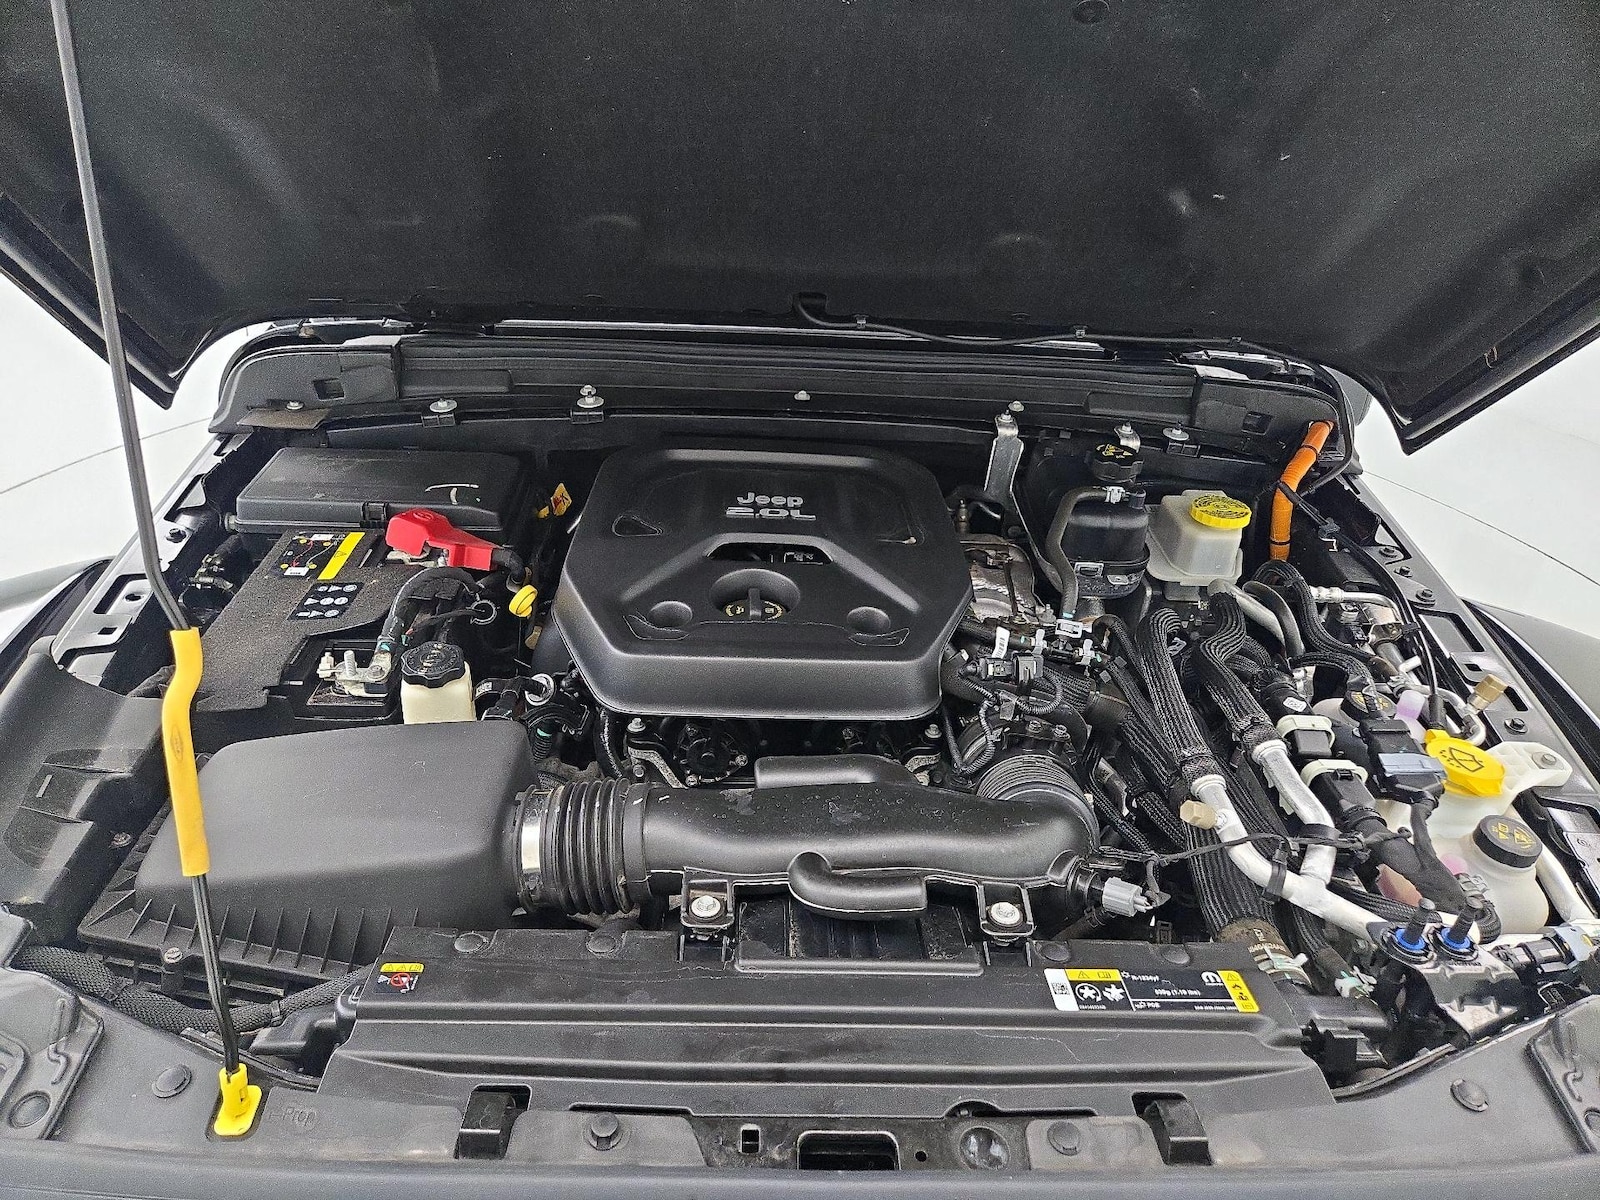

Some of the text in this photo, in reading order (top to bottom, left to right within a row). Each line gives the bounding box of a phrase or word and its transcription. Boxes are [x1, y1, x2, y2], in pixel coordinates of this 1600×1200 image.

[737, 491, 803, 507] Jeep
[726, 506, 816, 521] 2.0L
[283, 1106, 316, 1126] Prop
